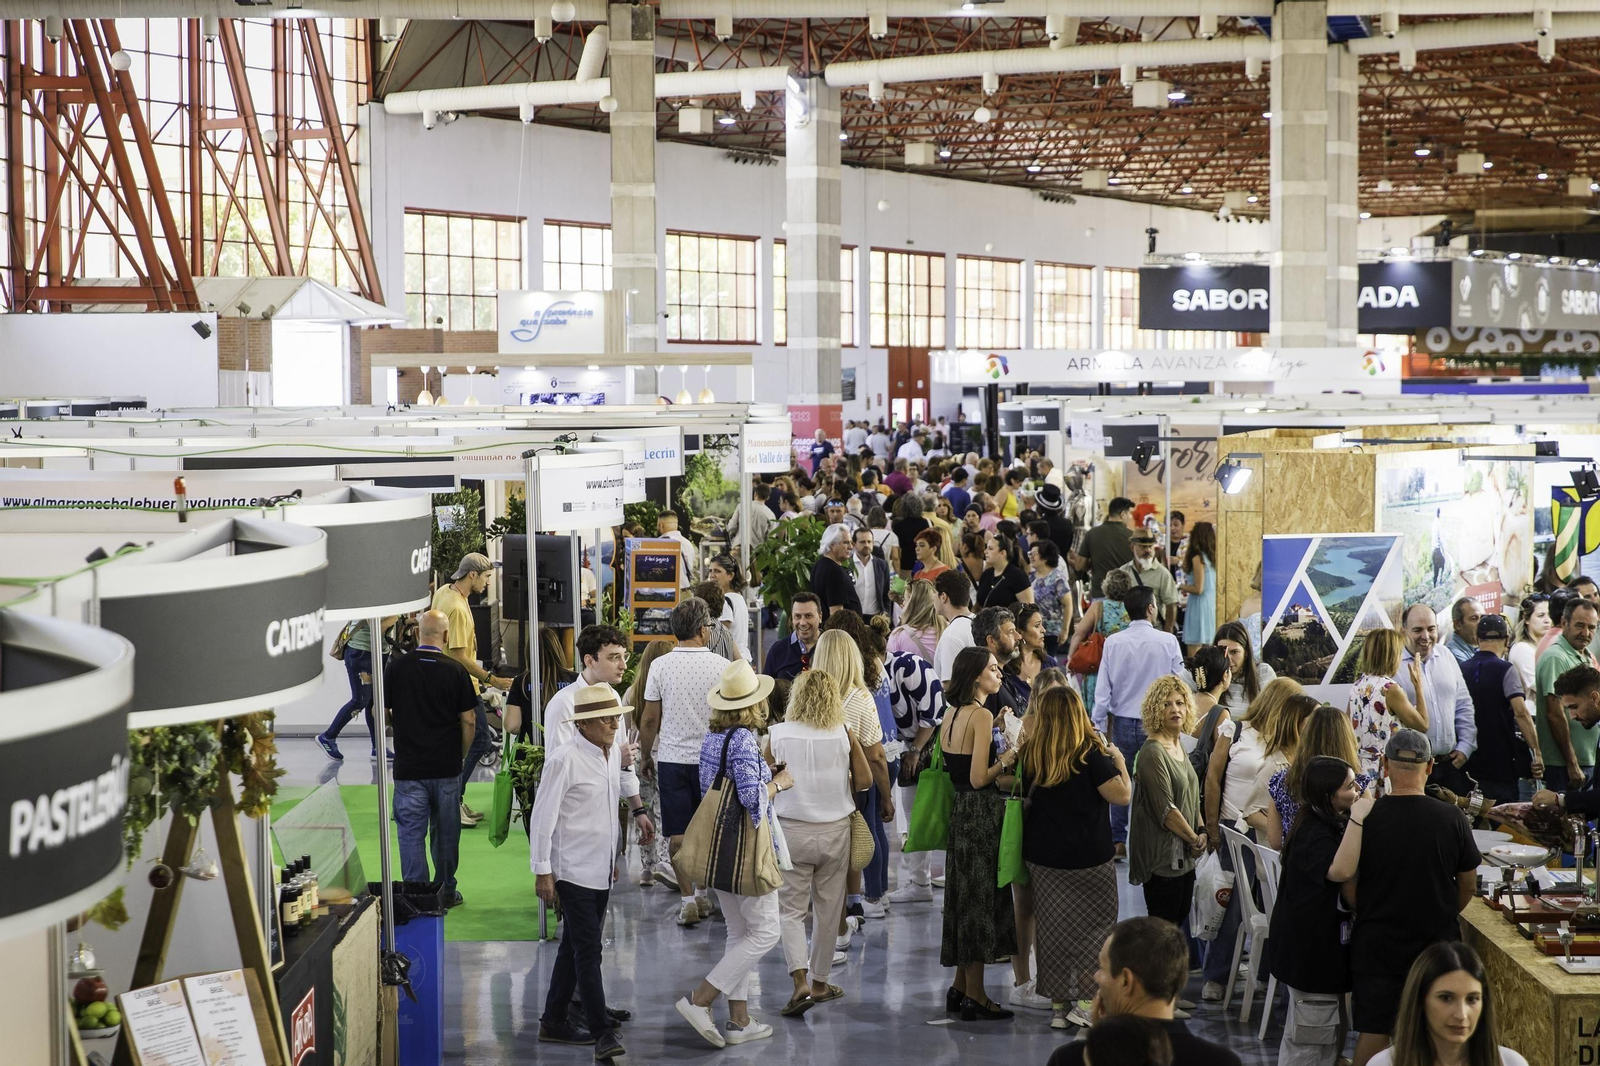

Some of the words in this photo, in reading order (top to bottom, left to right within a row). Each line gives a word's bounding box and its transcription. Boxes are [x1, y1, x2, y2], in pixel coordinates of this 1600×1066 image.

[1172, 288, 1269, 311] SABOR
[1357, 285, 1420, 308] ADA
[1561, 288, 1598, 315] SABOR
[1150, 356, 1227, 370] AVANZA
[758, 452, 775, 464] Valle
[1579, 1045, 1600, 1065] D
